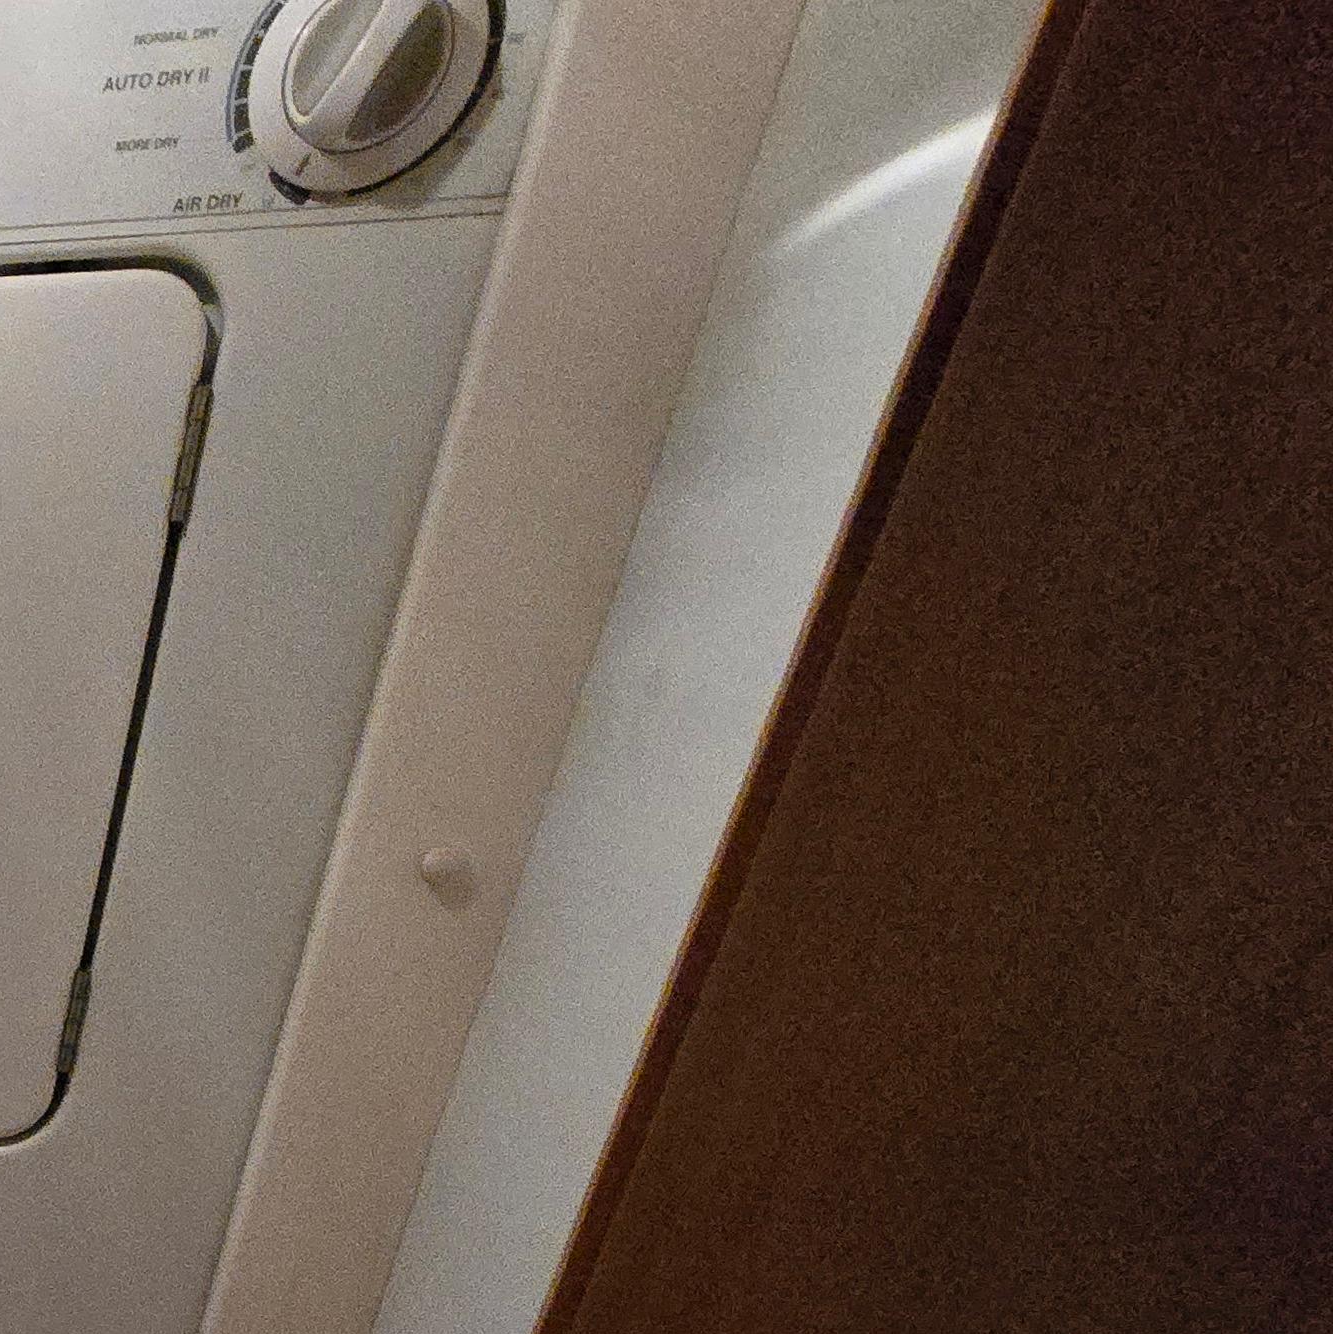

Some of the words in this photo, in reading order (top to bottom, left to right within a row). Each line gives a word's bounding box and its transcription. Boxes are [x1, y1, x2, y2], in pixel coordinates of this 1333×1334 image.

[134, 29, 188, 46] NORMAL
[193, 26, 220, 40] DRY
[102, 71, 153, 93] AUTO
[157, 68, 195, 87] DRY
[198, 66, 211, 84] II
[115, 138, 151, 152] MORE
[153, 136, 181, 150] DRY
[173, 196, 203, 213] AIR
[207, 191, 244, 210] DRY
